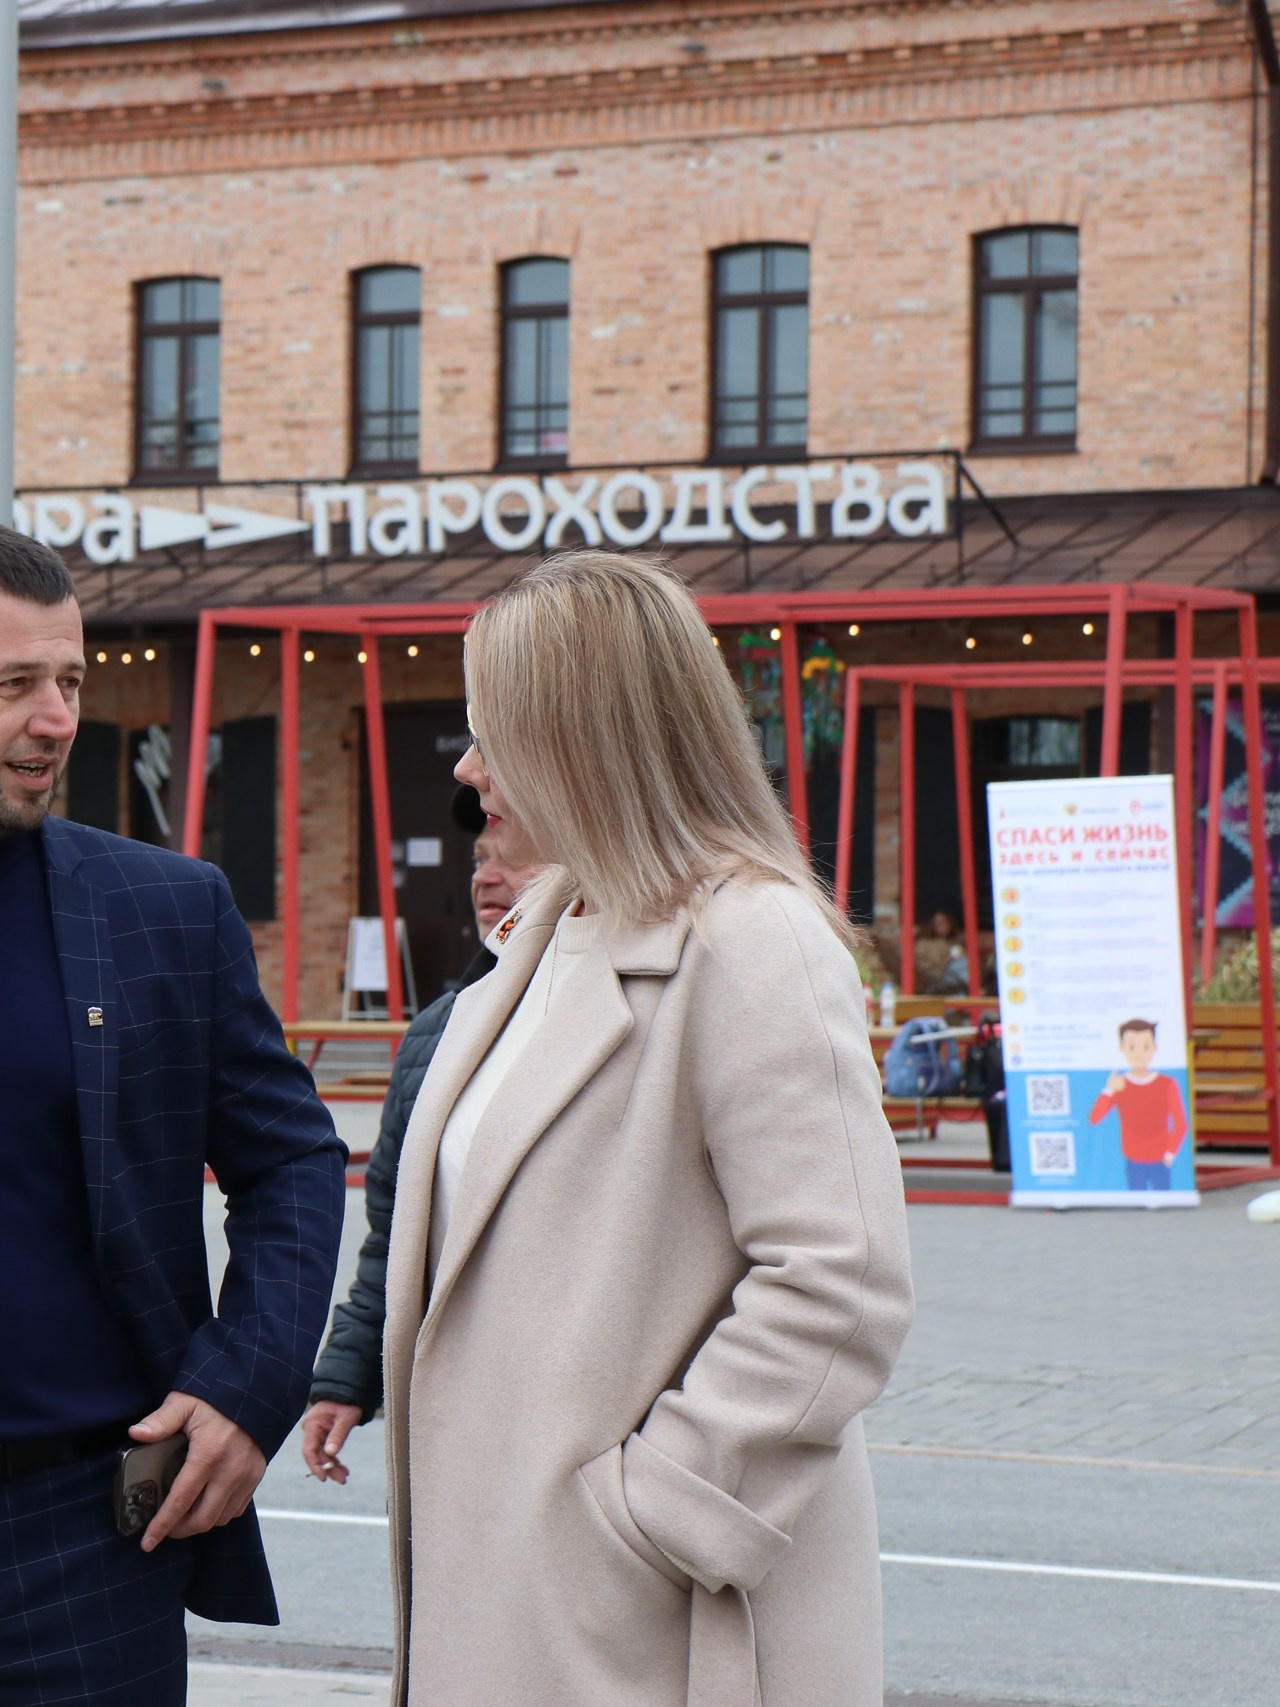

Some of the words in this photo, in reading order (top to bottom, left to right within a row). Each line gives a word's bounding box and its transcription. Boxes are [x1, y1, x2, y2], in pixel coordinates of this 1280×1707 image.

[996, 826, 1075, 847] СПАСИ
[1082, 823, 1168, 844] ЖИЗНЬ
[999, 851, 1059, 866] здесь
[1071, 850, 1083, 862] и
[1094, 846, 1169, 863] сейчас
